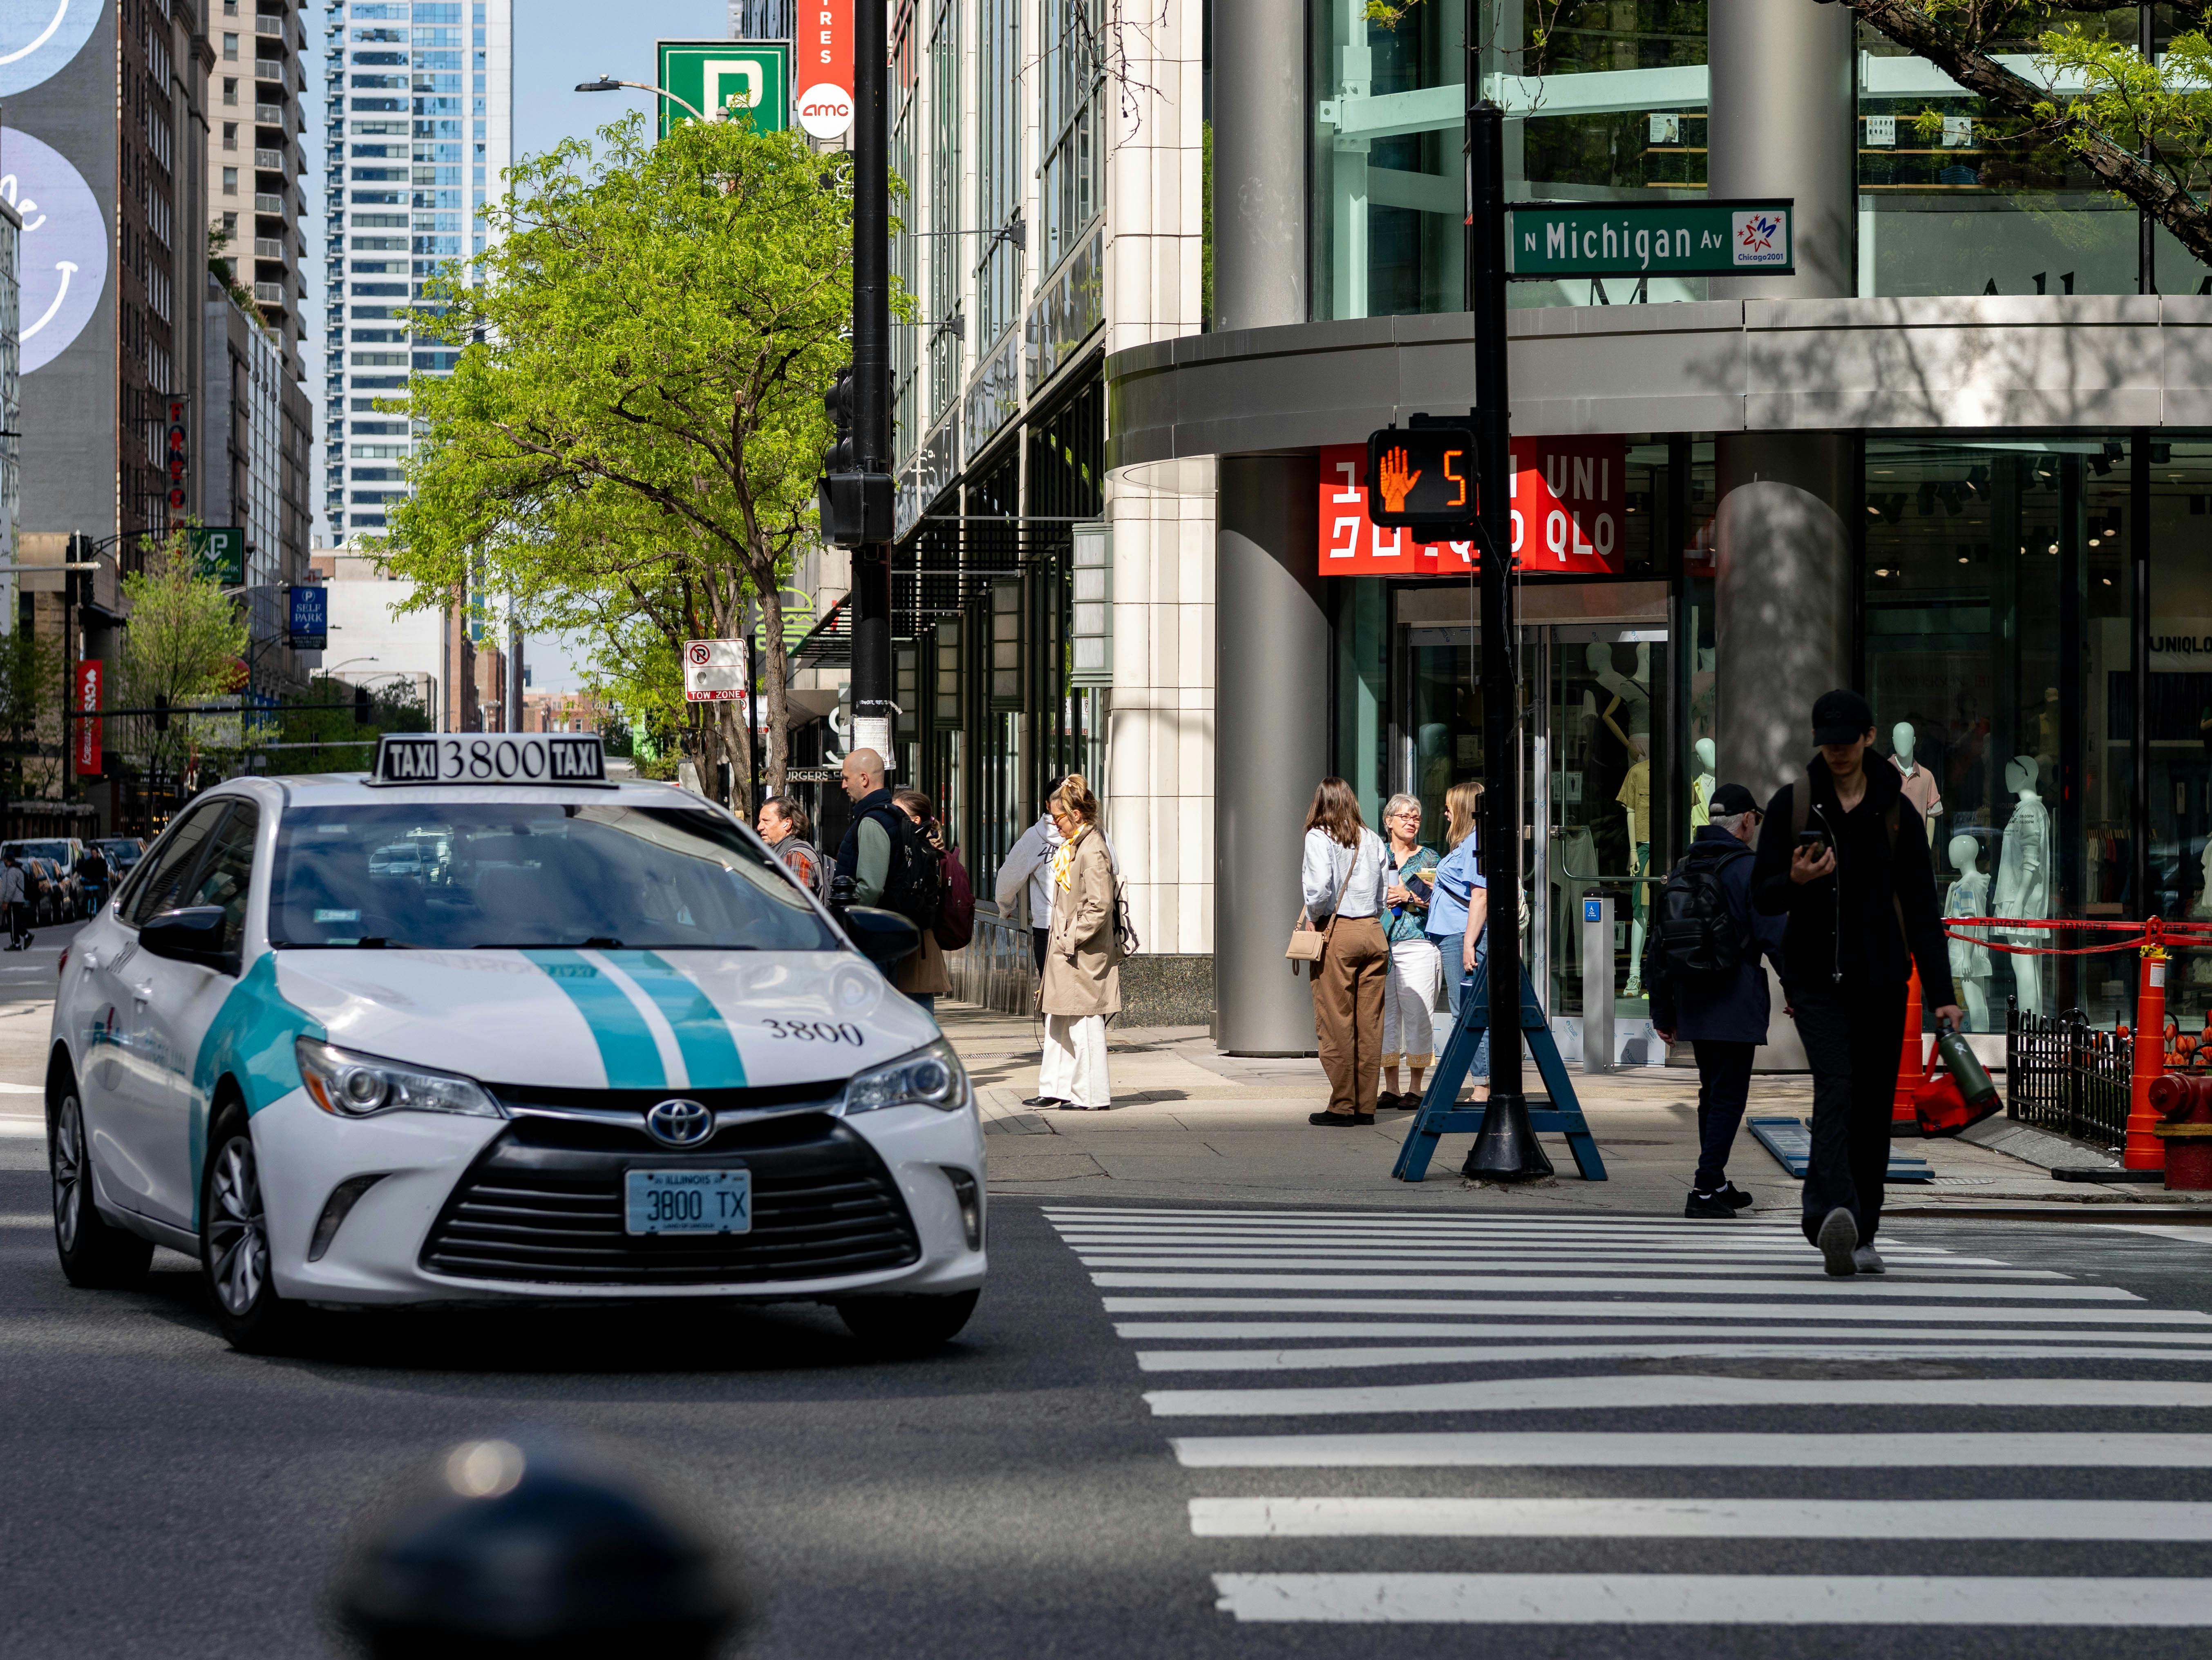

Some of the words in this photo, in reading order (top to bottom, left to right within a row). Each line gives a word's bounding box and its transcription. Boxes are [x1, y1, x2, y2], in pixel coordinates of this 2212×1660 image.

[820, 0, 832, 63] RES
[803, 104, 848, 116] amc
[1525, 232, 1536, 251] N
[1547, 221, 1690, 270] Michigan
[1701, 230, 1722, 248] Av
[1738, 253, 1784, 262] Chicago2001
[1333, 462, 1361, 503] ユ
[1444, 450, 1465, 506] 5
[1547, 455, 1608, 501] UNI
[1329, 516, 1401, 559] クロ
[1546, 509, 1614, 562] QLO
[295, 613, 322, 622] PARK
[296, 603, 321, 612] SELF
[2149, 636, 2212, 654] UNIQLO
[84, 682, 96, 712] CVS
[389, 744, 436, 777] TAXI
[443, 740, 545, 778] 3800
[552, 743, 597, 776] TAXI
[1979, 919, 2028, 928] DANGER
[2059, 922, 2108, 930] DANGER
[762, 1018, 864, 1047] 3800
[666, 1175, 711, 1184] ILLINOIS
[647, 1190, 702, 1220] 3800
[716, 1191, 746, 1218] TX
